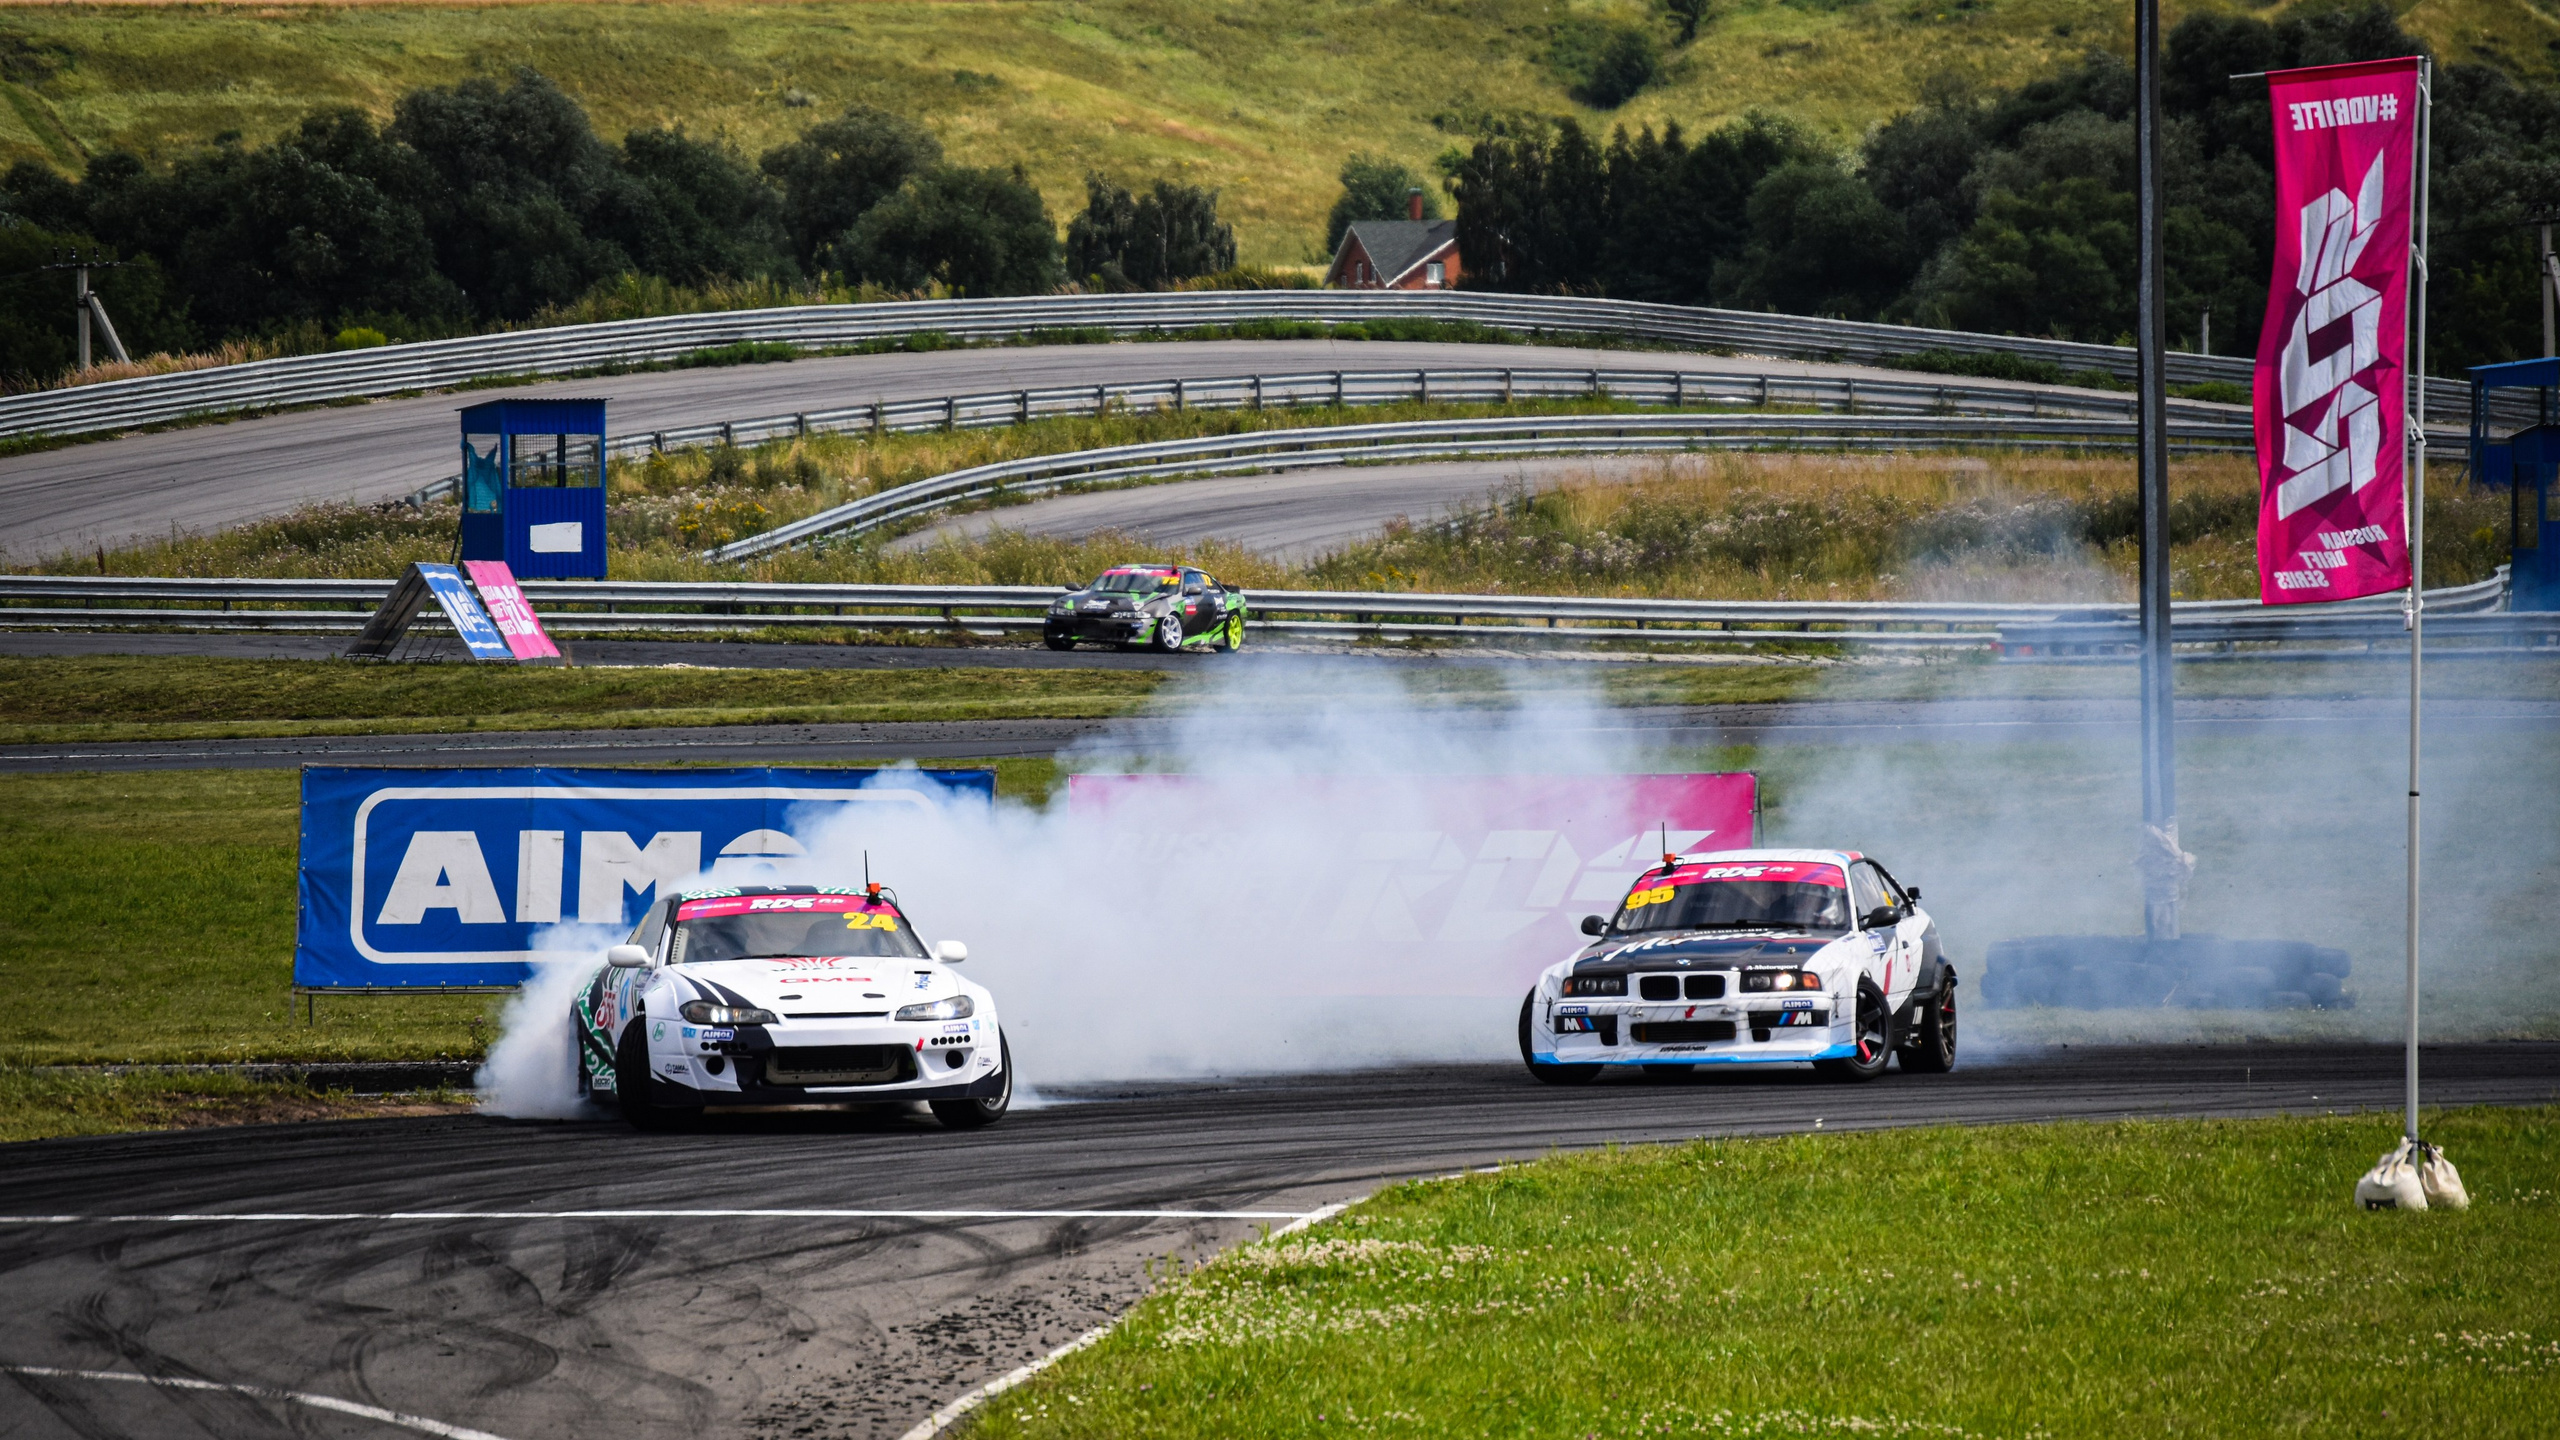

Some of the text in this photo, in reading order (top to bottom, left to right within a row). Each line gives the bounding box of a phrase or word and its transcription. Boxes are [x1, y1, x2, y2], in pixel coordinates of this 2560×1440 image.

[1625, 884, 1675, 909] 95
[843, 912, 898, 932] 24
[1783, 1001, 1813, 1009] AIMOL
[1561, 1006, 1588, 1014] AIMOL
[702, 1031, 732, 1039] AIMOL
